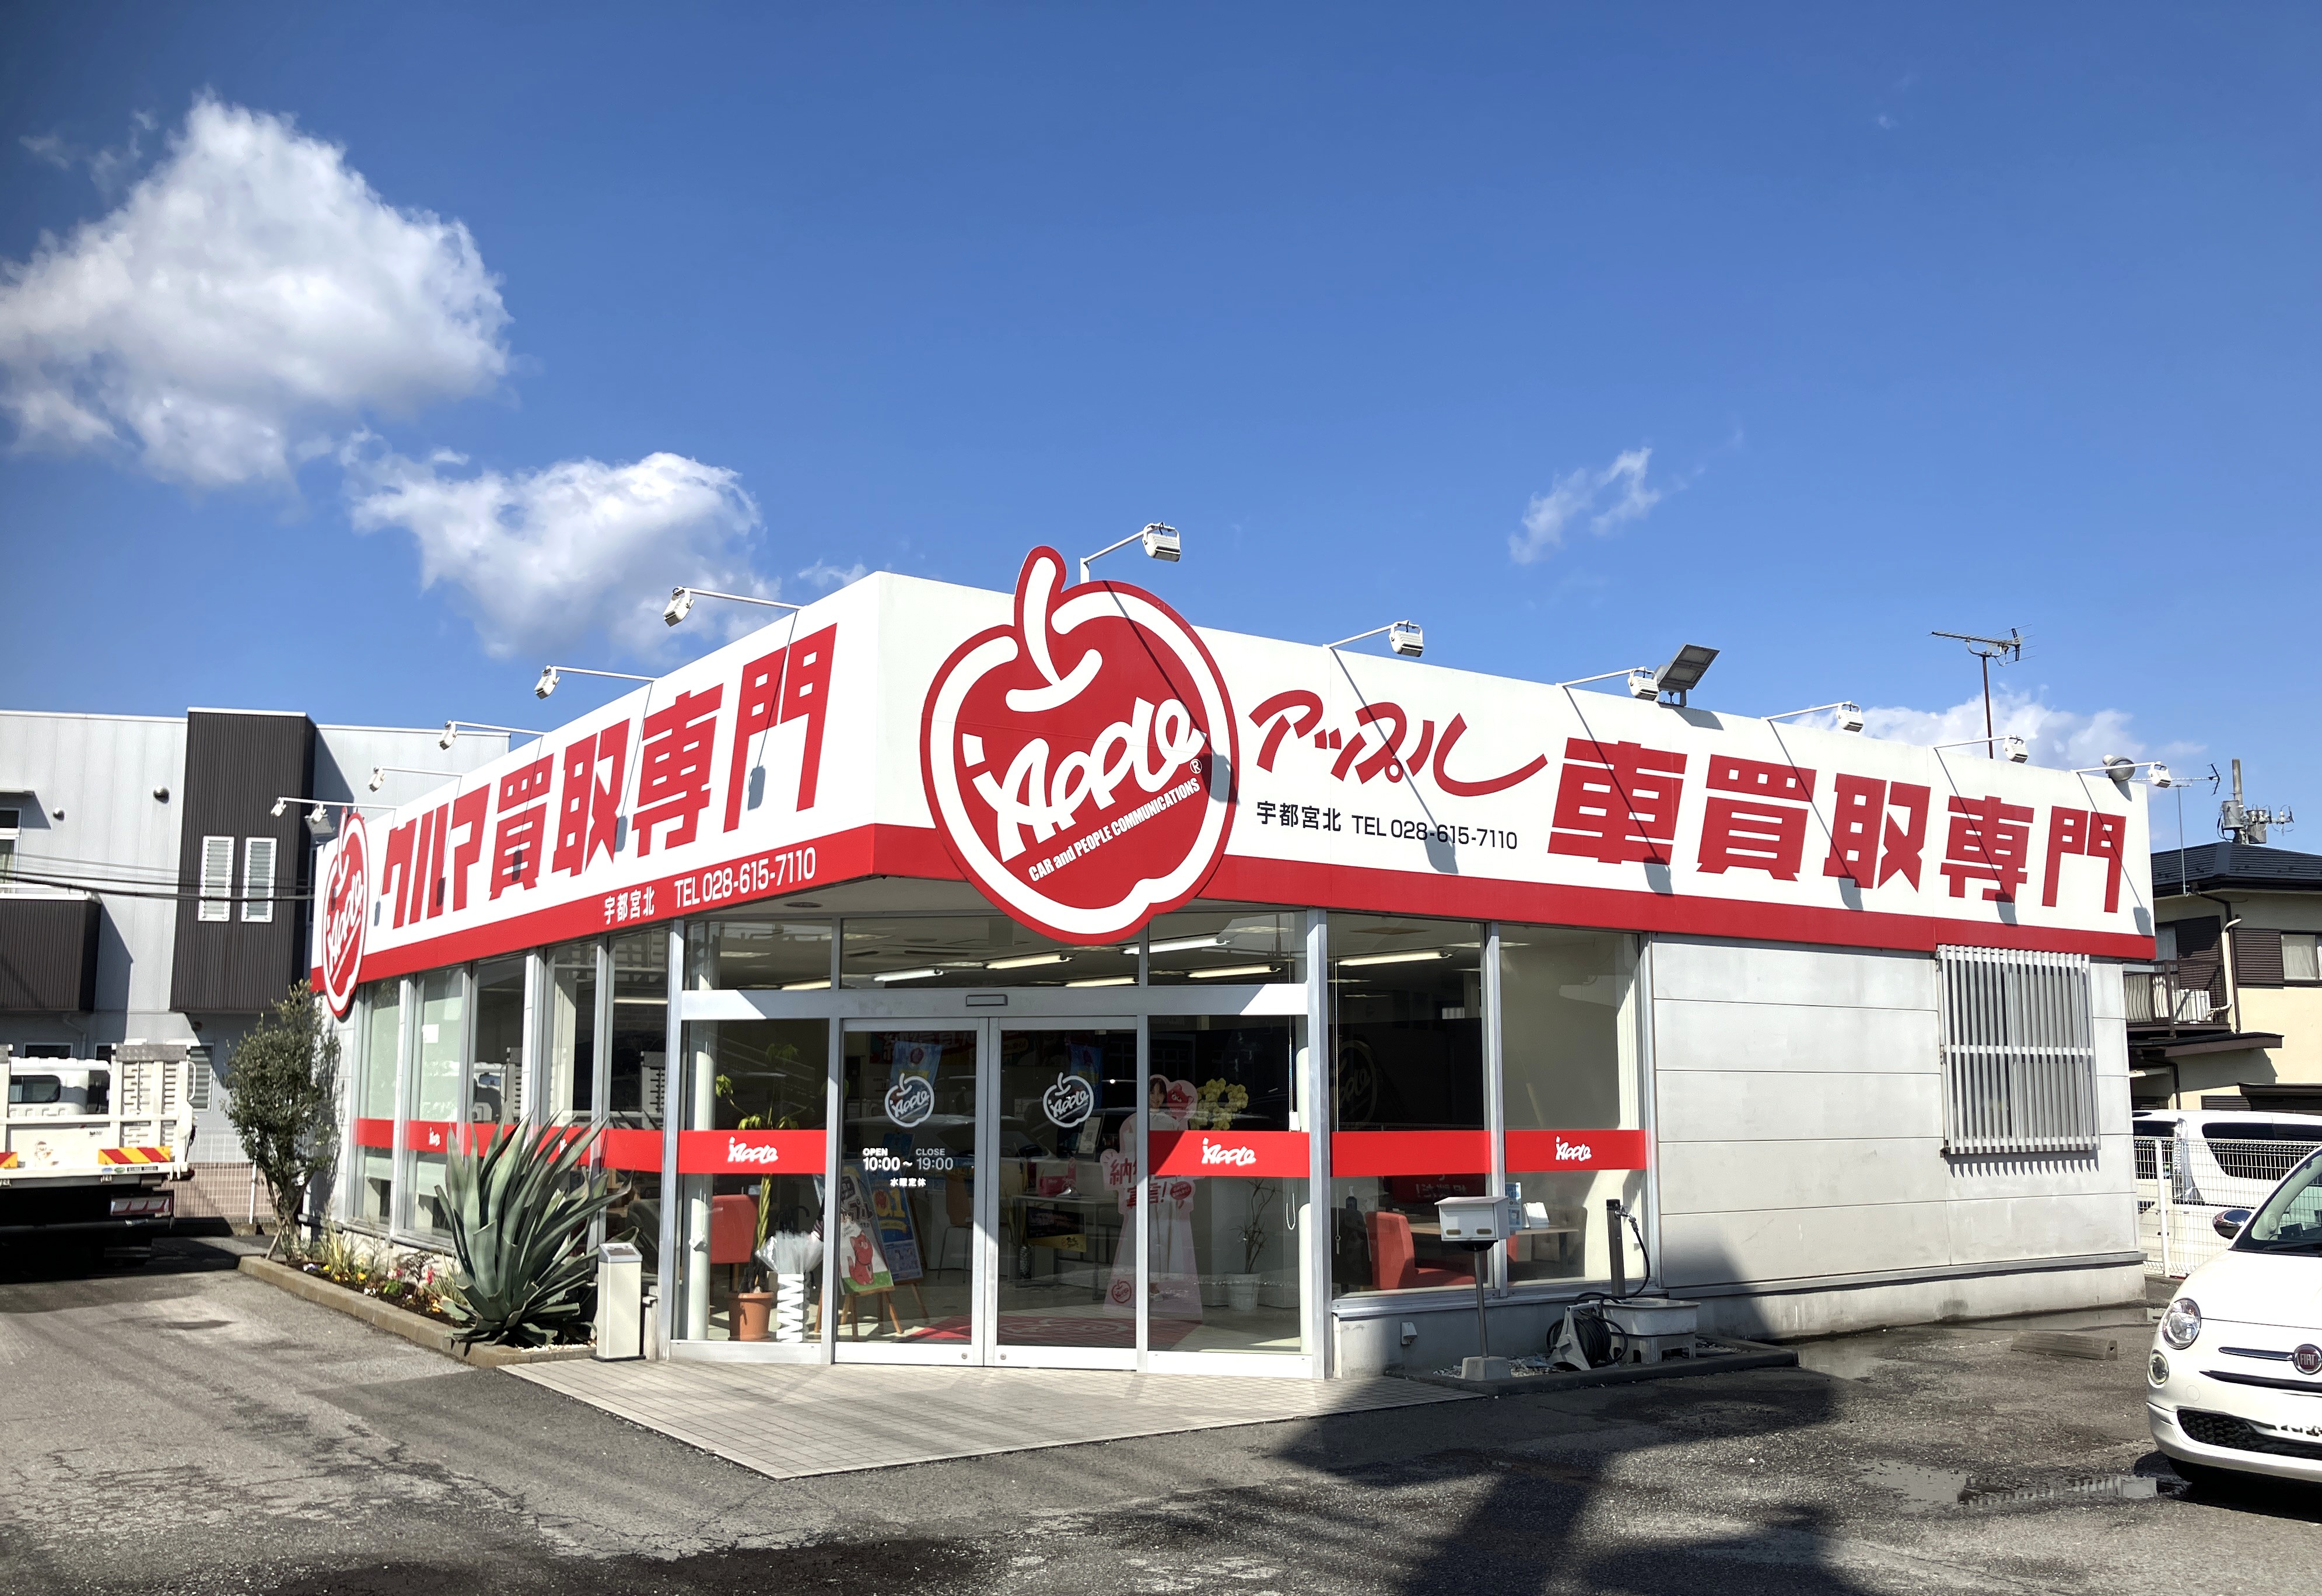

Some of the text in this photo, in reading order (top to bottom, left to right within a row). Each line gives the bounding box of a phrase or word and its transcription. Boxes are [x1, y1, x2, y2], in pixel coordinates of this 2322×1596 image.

[381, 622, 838, 929] クルマ買取専門
[1249, 690, 2127, 914] アップル 車買取専門
[1028, 778, 1200, 881] CAR and PEOPLE COMMUNICATIONS
[1257, 801, 1517, 849] 宇都宮北 TEL 028-615-7110
[604, 846, 816, 925] 宇都宮北 TEL 028-615-7110
[862, 1147, 888, 1156] OPEN
[863, 1156, 901, 1171] 10:00
[916, 1156, 954, 1171] 19:00
[915, 1148, 945, 1156] CLOSE
[890, 1177, 926, 1188] 水曜定休
[2300, 1353, 2316, 1366] FIAT
